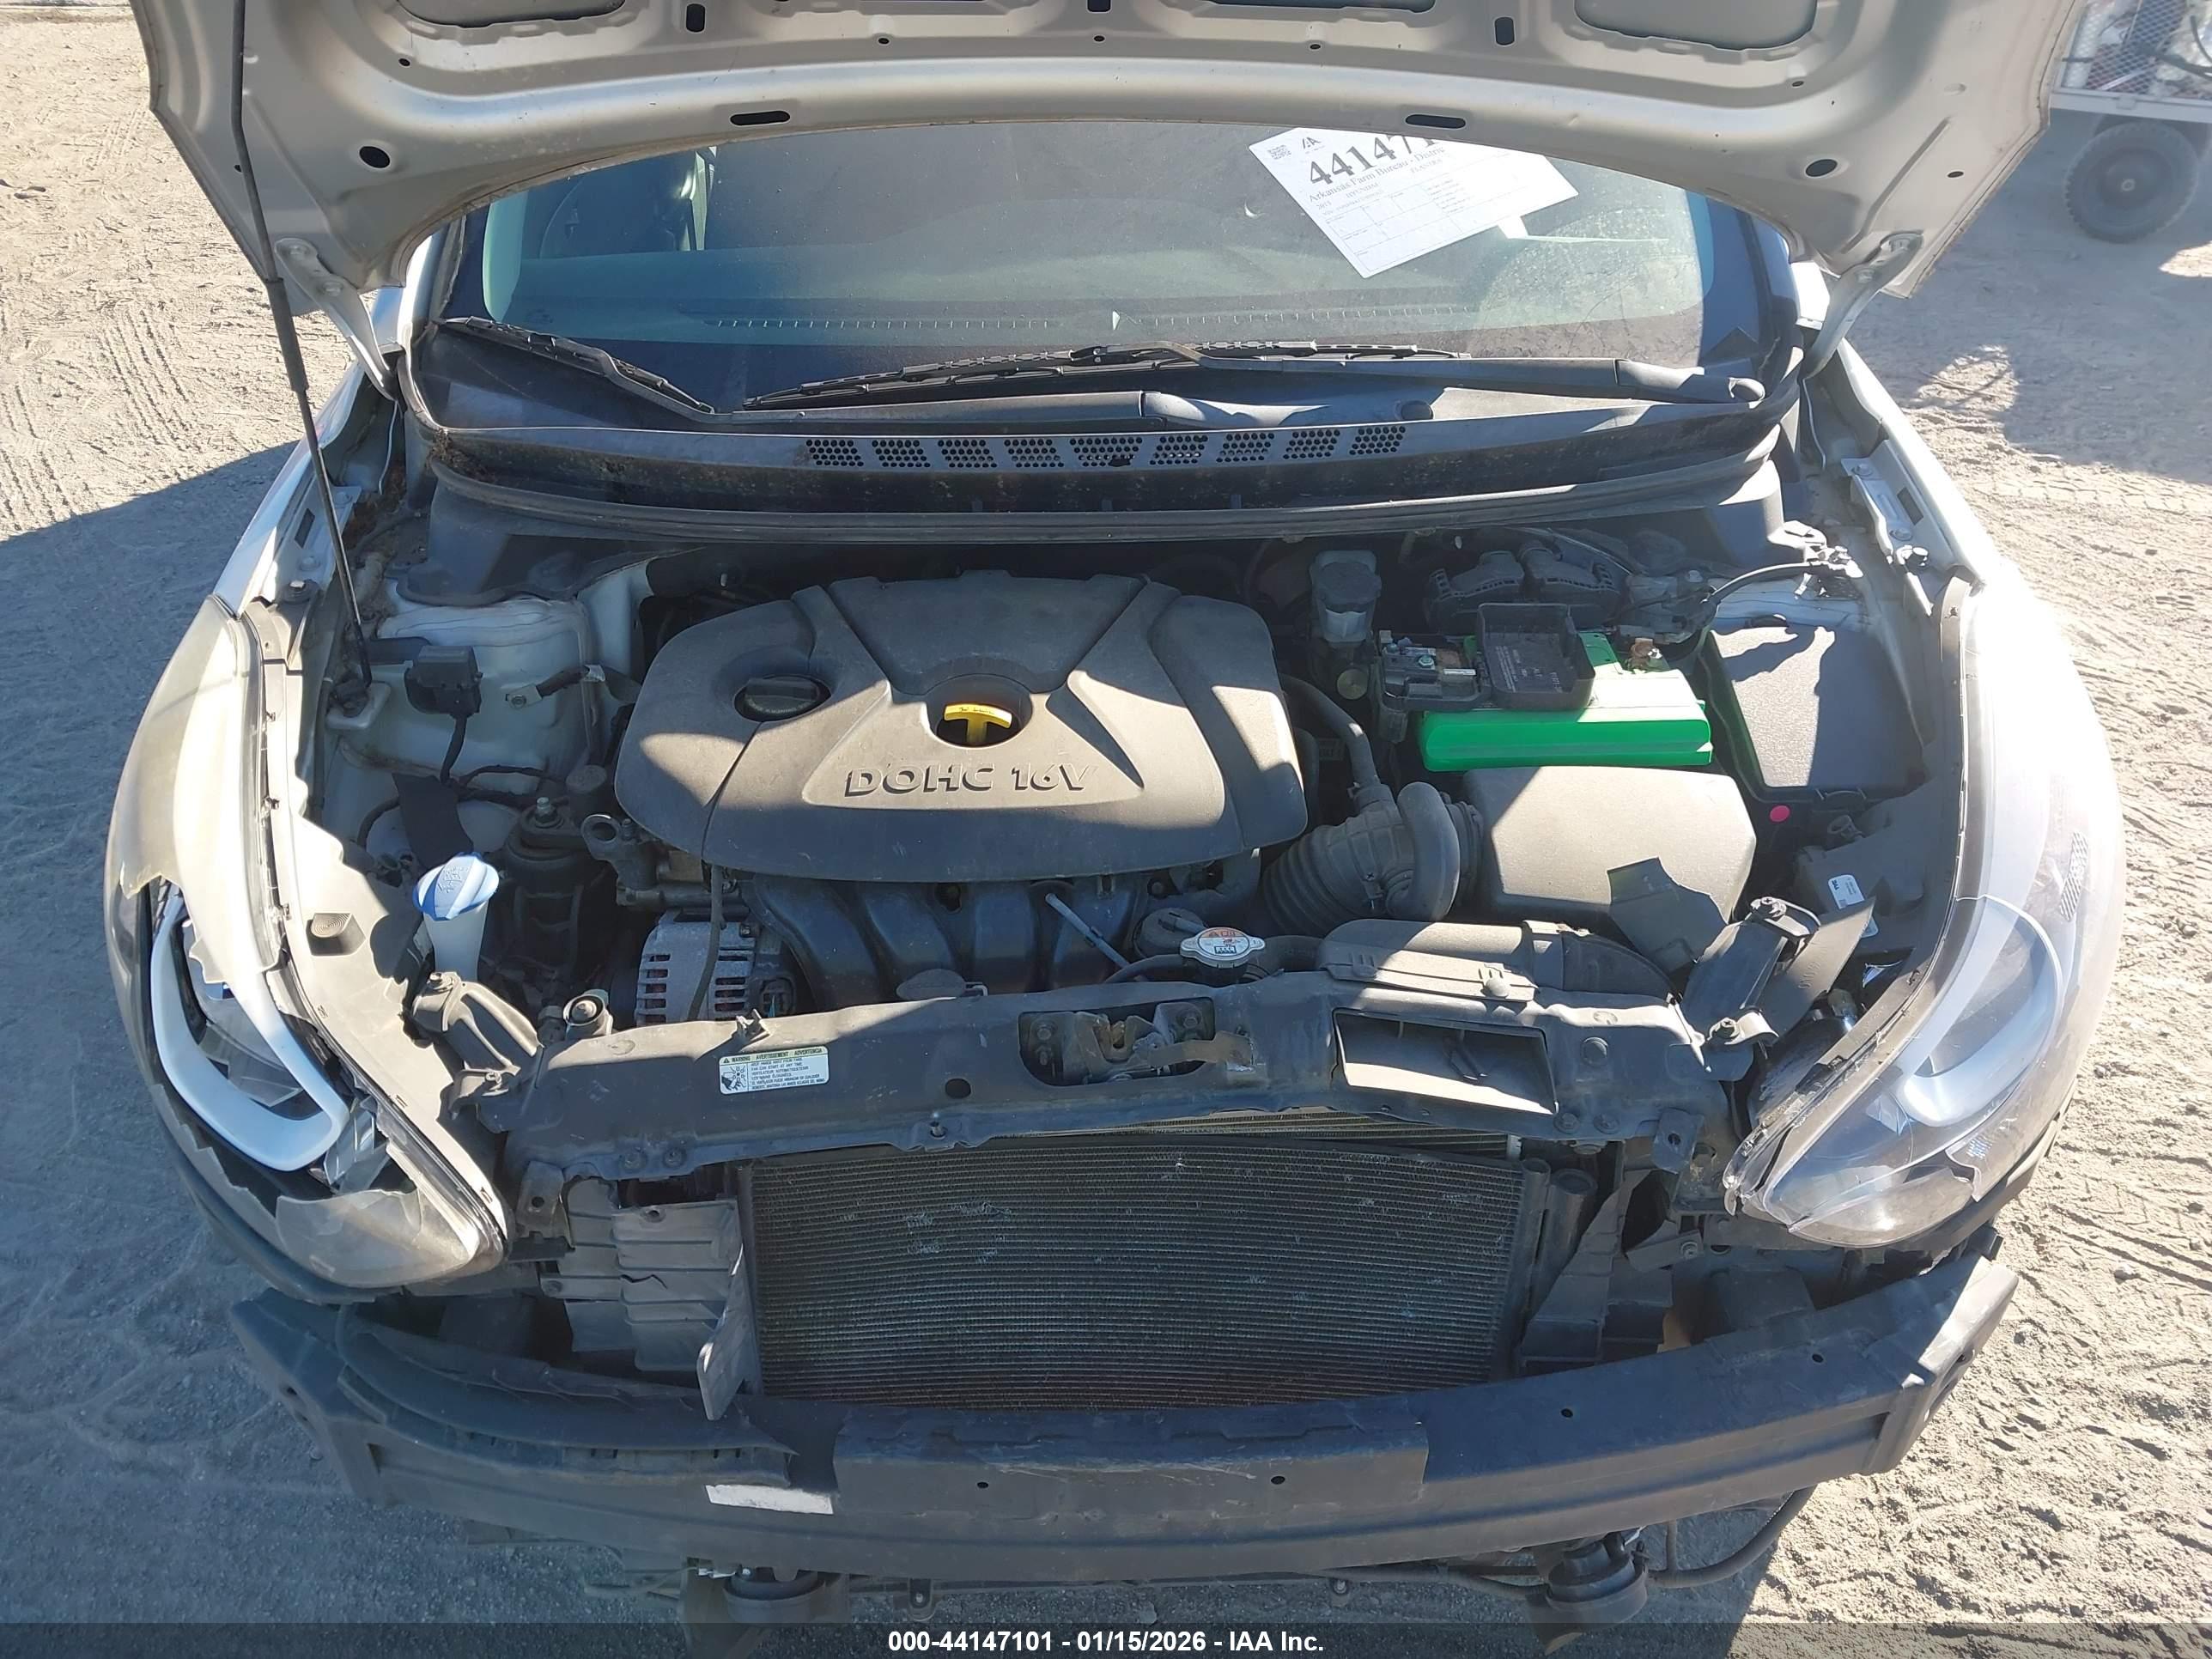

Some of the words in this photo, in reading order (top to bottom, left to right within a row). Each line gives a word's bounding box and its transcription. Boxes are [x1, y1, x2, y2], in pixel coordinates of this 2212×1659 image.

[1310, 182, 1352, 203] Arkansas
[1351, 173, 1376, 187] Farm
[1376, 161, 1409, 176] Bureau
[844, 763, 995, 798] DOHC
[1011, 763, 1098, 792] 16V
